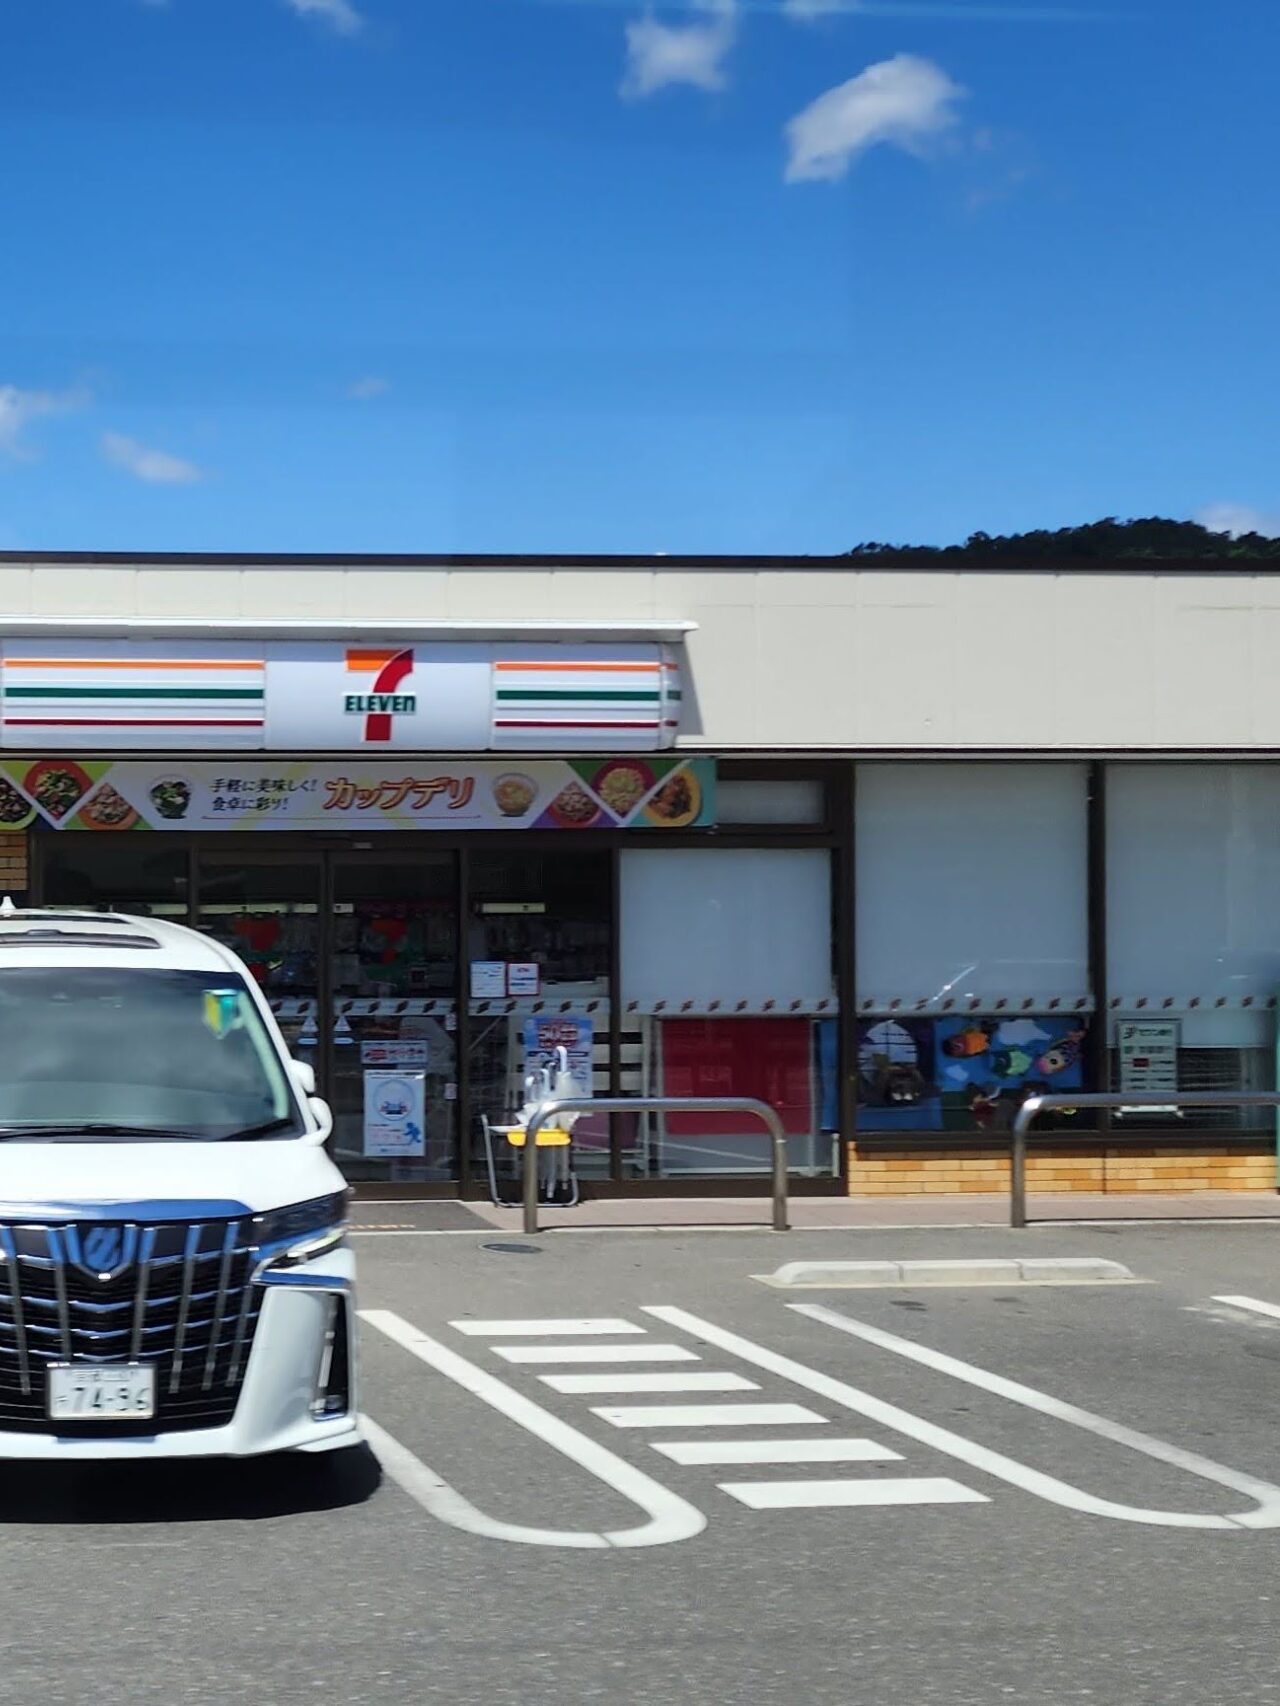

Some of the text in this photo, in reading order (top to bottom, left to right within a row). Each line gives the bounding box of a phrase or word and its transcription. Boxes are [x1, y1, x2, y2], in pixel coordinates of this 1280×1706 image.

[346, 648, 414, 741] 7
[323, 777, 475, 809] カップデリ
